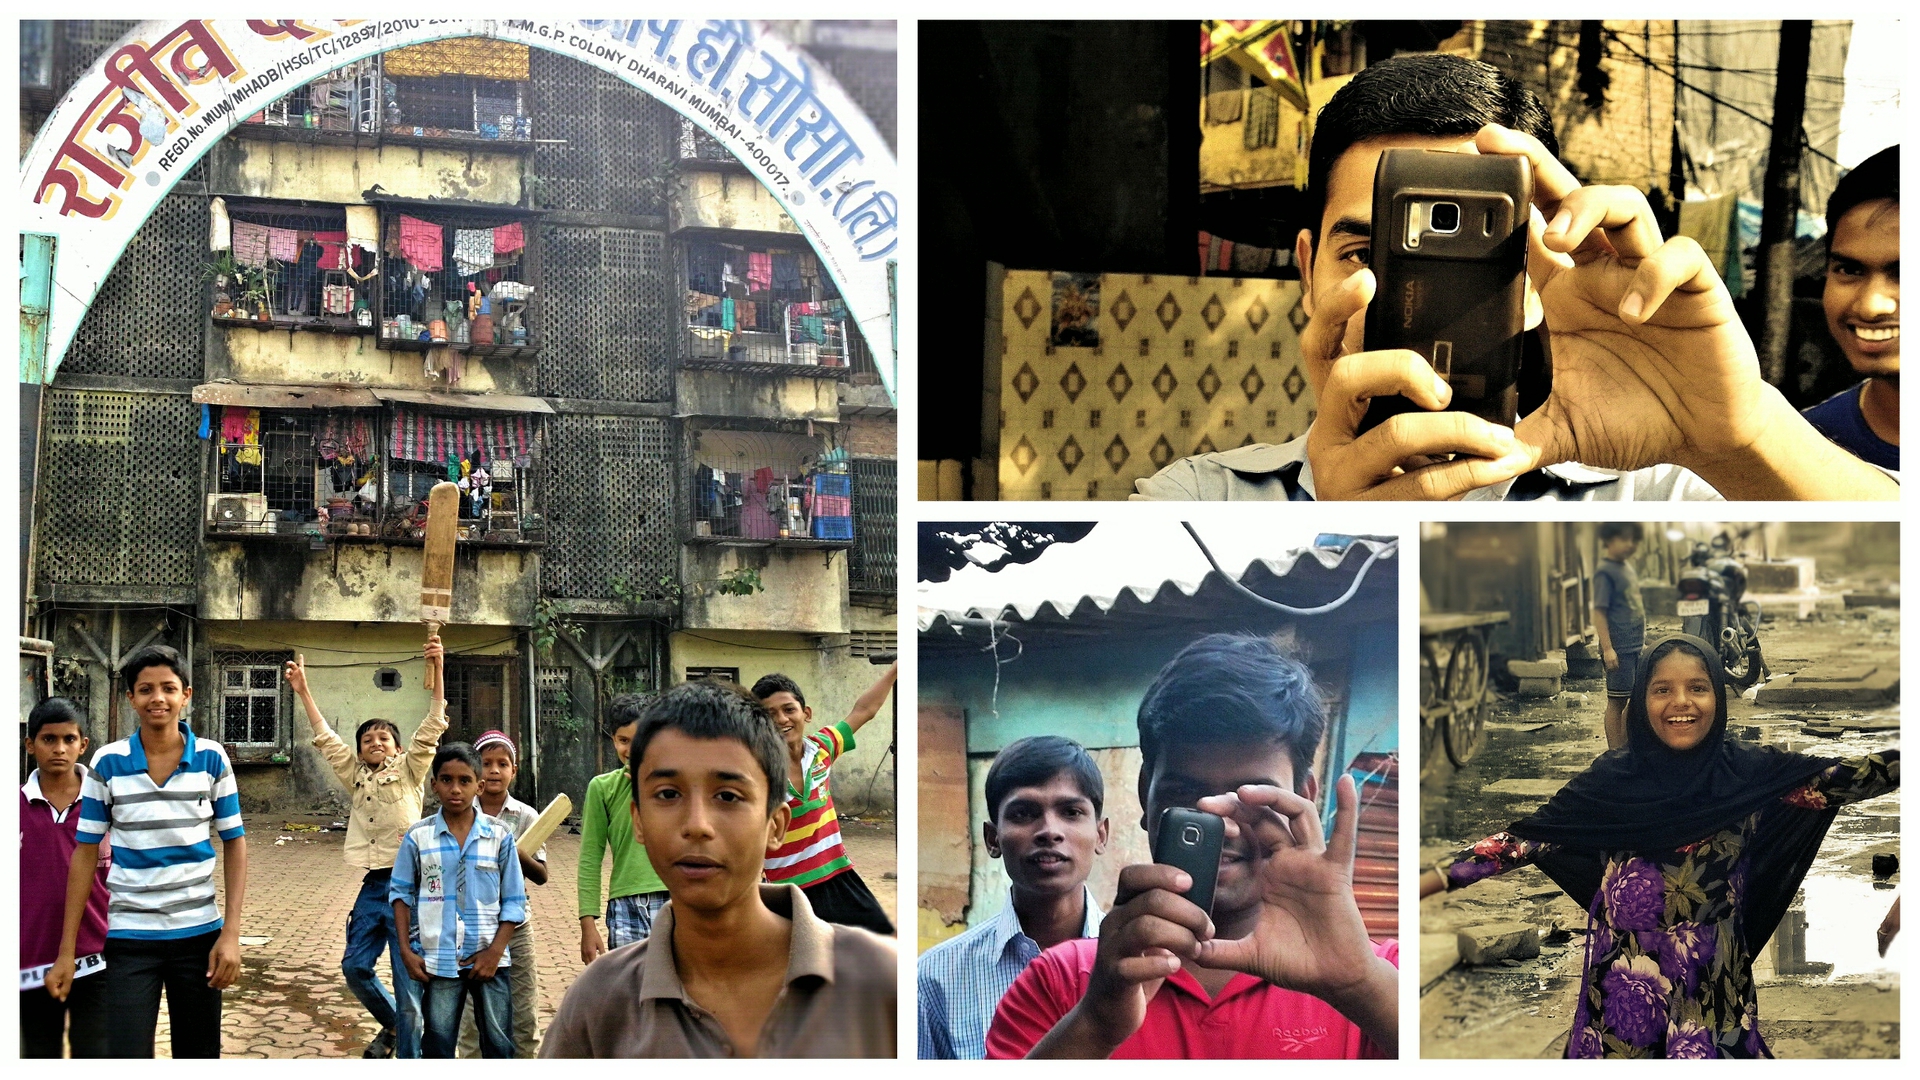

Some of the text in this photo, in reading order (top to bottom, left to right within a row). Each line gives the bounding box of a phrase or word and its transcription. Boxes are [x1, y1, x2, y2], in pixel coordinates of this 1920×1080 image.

[569, 35, 626, 65] COLONY
[627, 59, 687, 100] DHARAVI
[1403, 281, 1414, 328] NOKIA
[1272, 1026, 1329, 1039] Reebok
